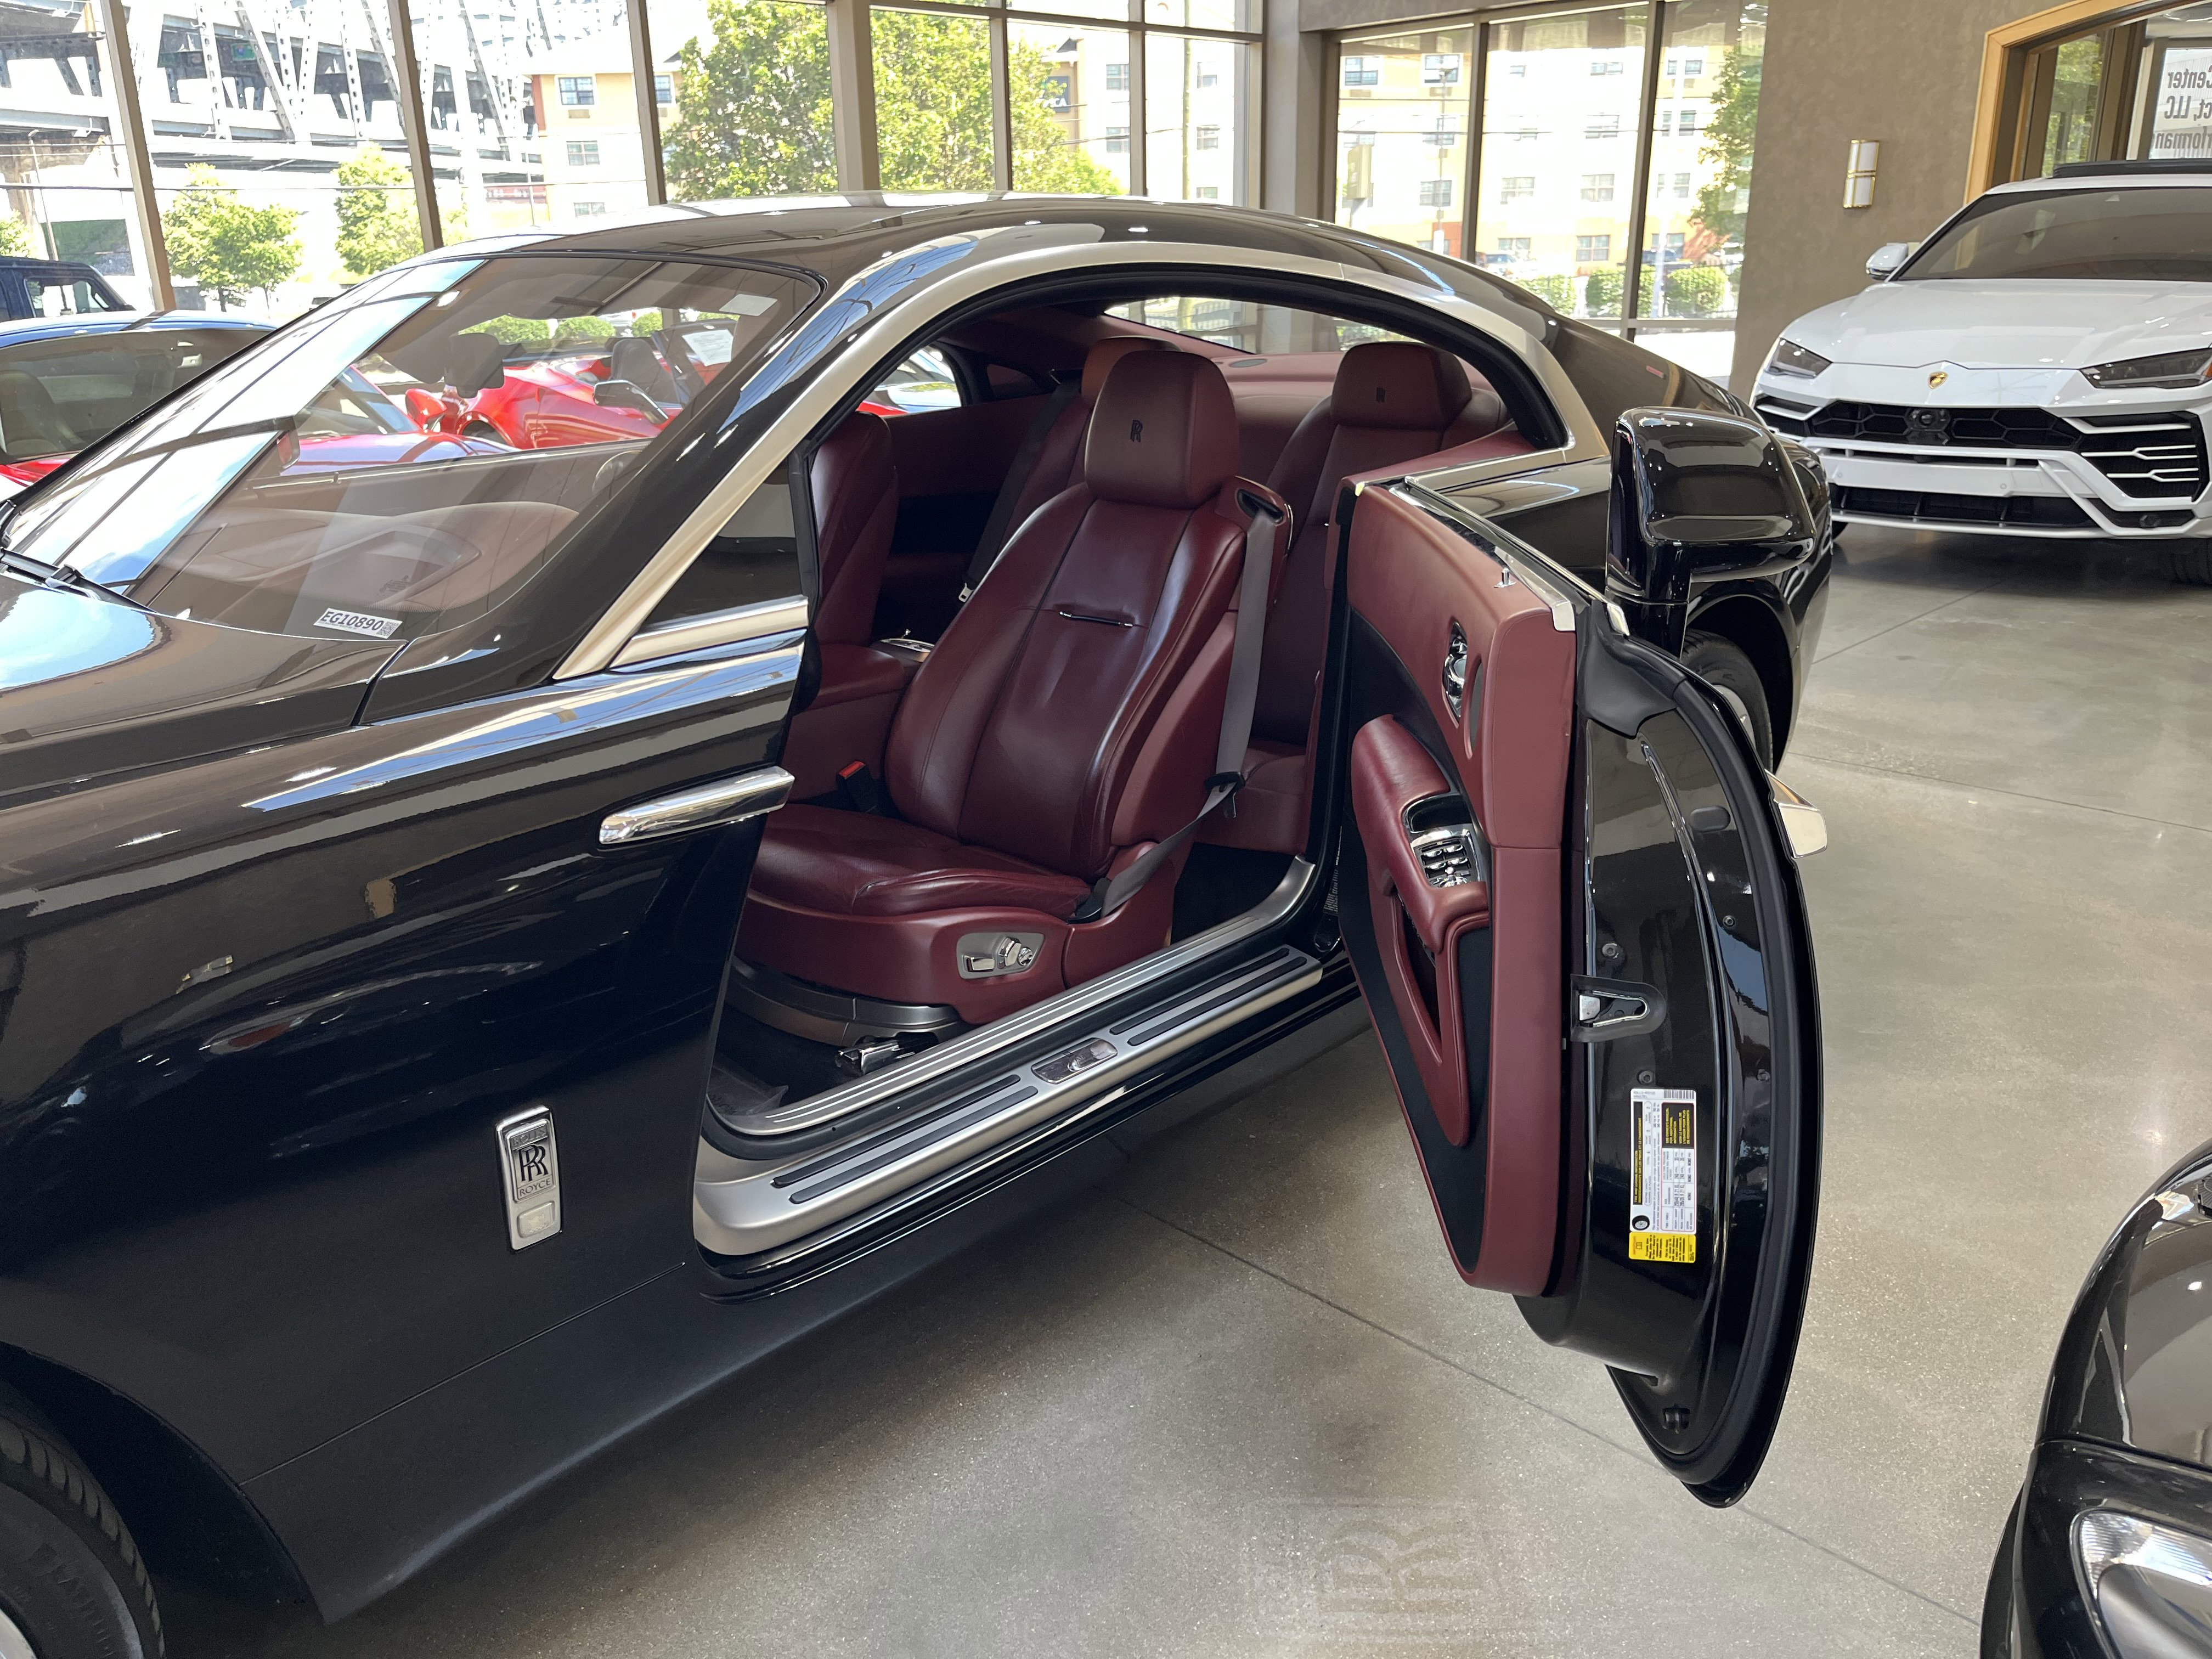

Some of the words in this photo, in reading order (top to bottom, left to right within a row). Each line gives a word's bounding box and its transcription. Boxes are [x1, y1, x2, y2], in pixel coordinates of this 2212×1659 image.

[320, 611, 384, 630] EG10890
[512, 1129, 546, 1146] ROLLS
[518, 1144, 549, 1182] RR
[520, 1178, 551, 1197] ROYCE
